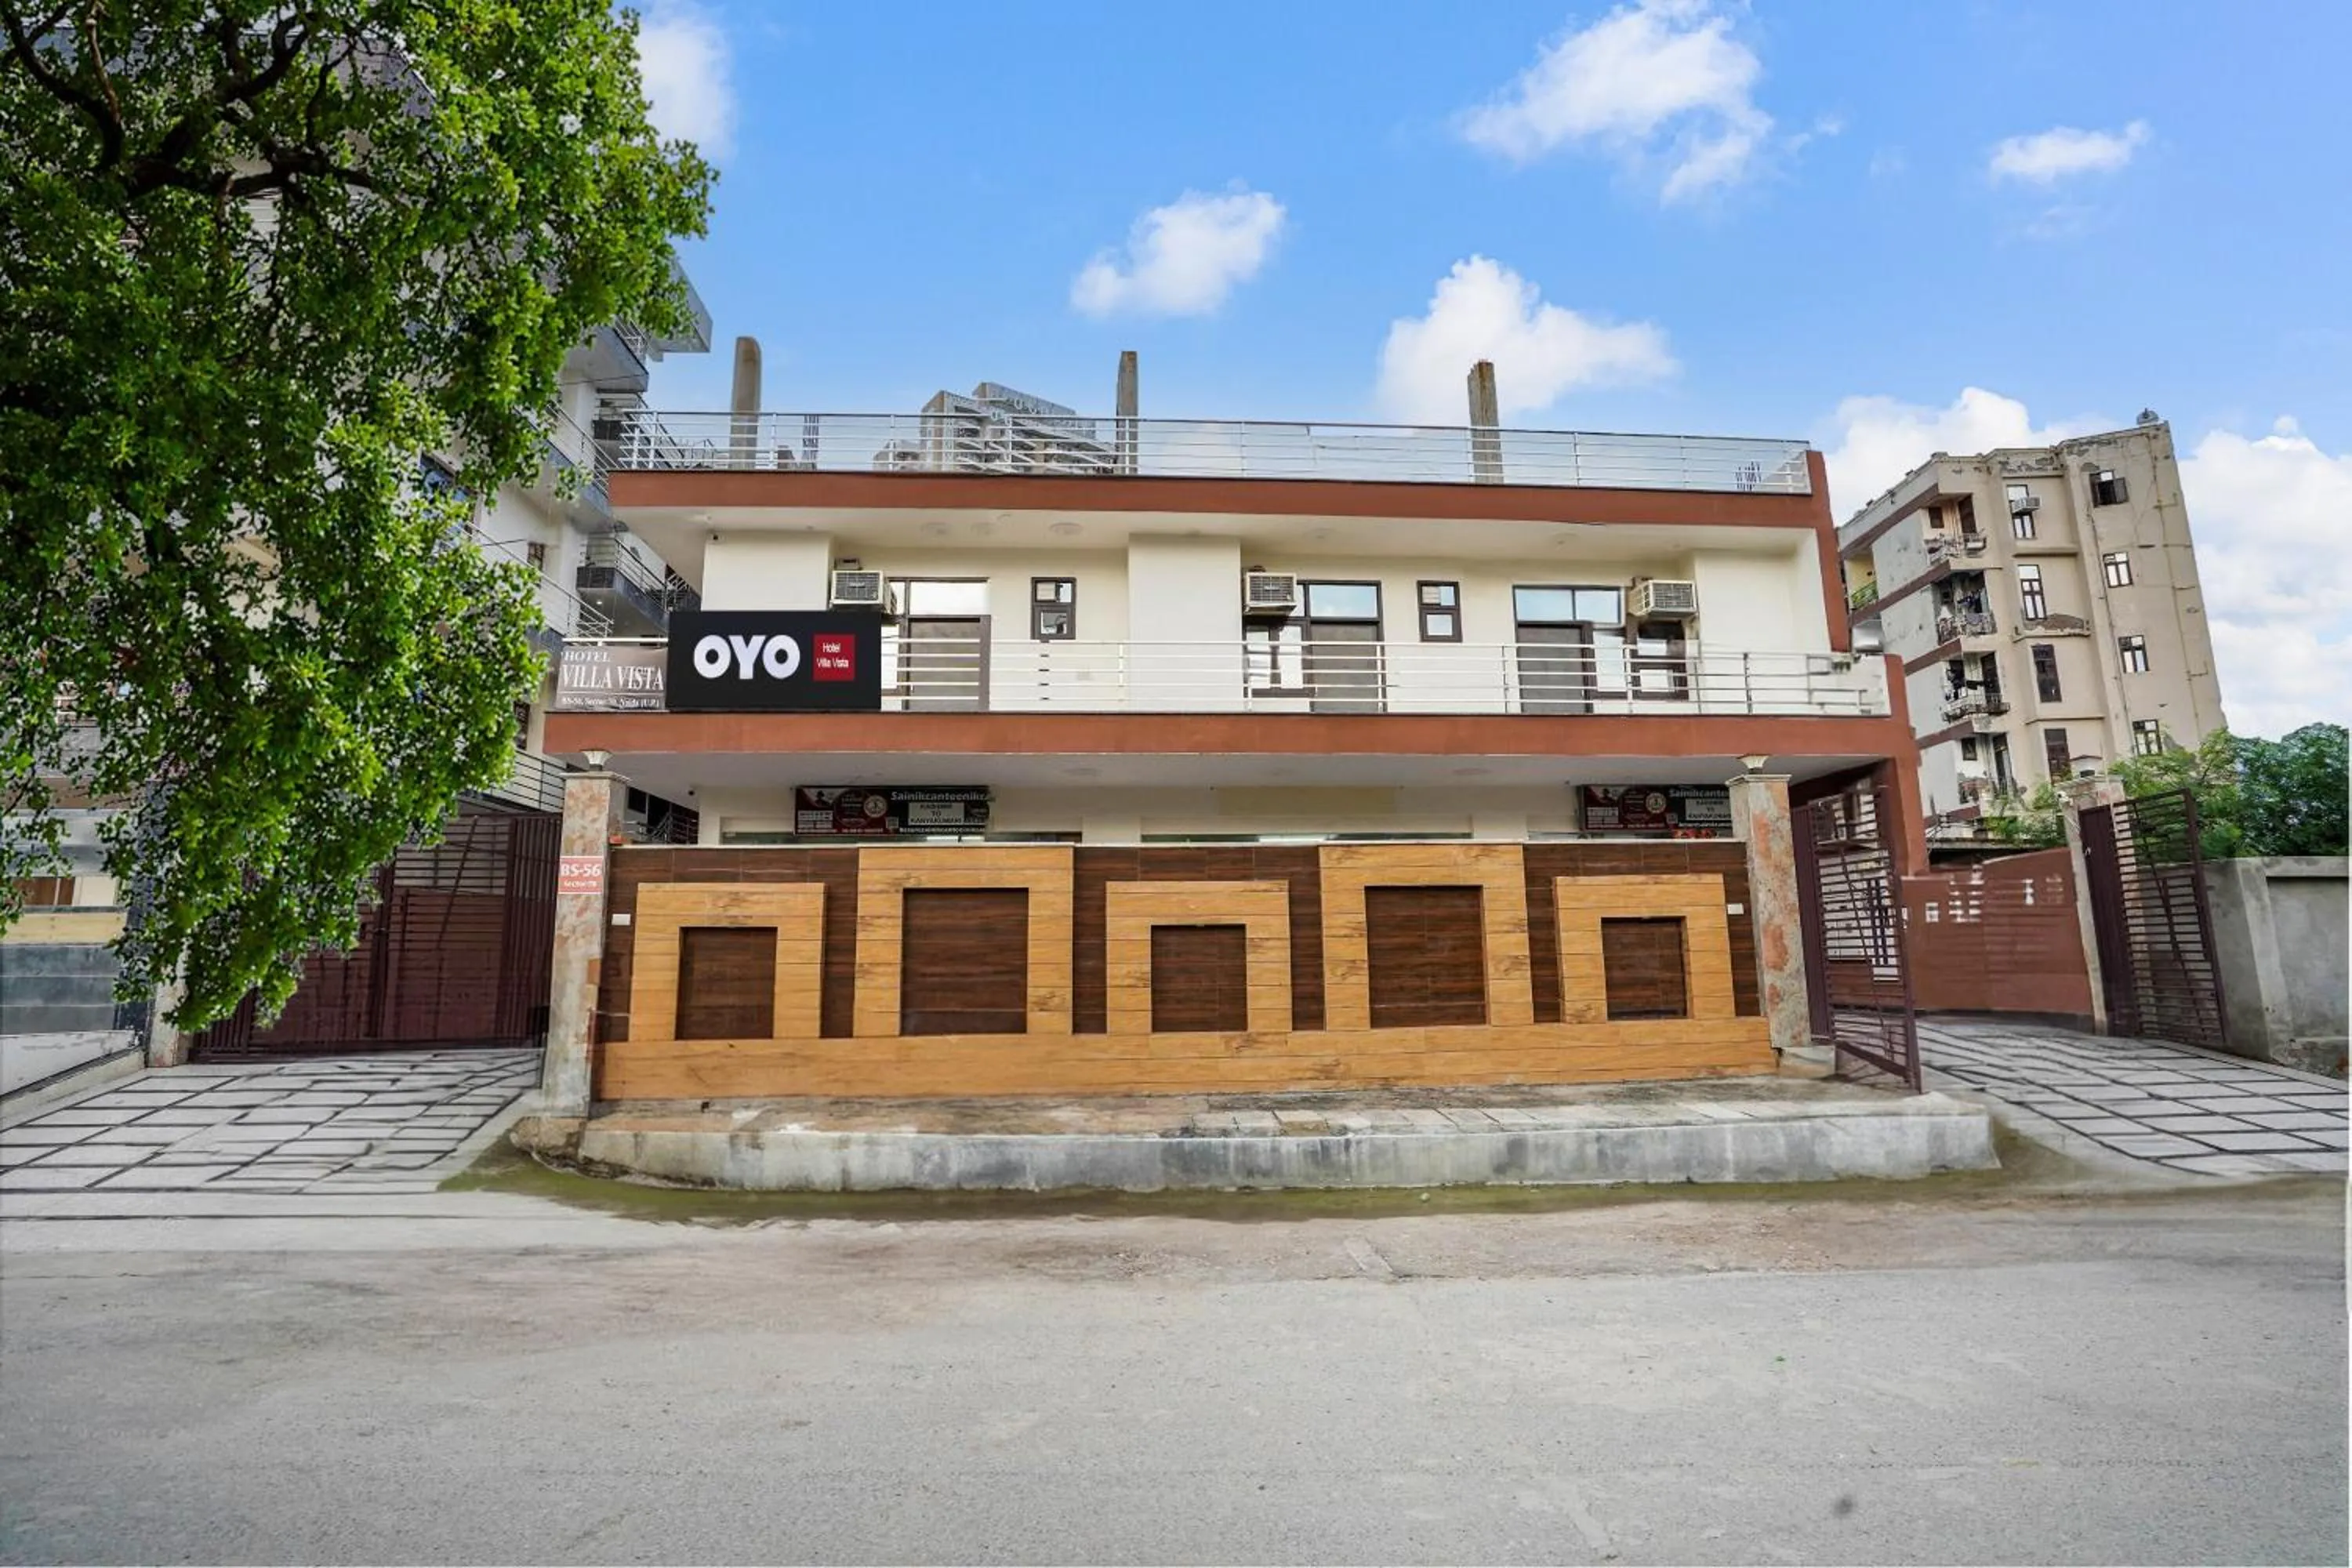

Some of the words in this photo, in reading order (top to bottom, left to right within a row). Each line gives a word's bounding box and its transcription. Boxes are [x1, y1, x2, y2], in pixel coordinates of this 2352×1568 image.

[822, 642, 841, 653] Hotel
[564, 652, 612, 662] HOTEL
[693, 633, 801, 680] OYO
[562, 663, 612, 689] VILLA
[616, 665, 664, 691] VISTA
[561, 862, 601, 877] BS-56
